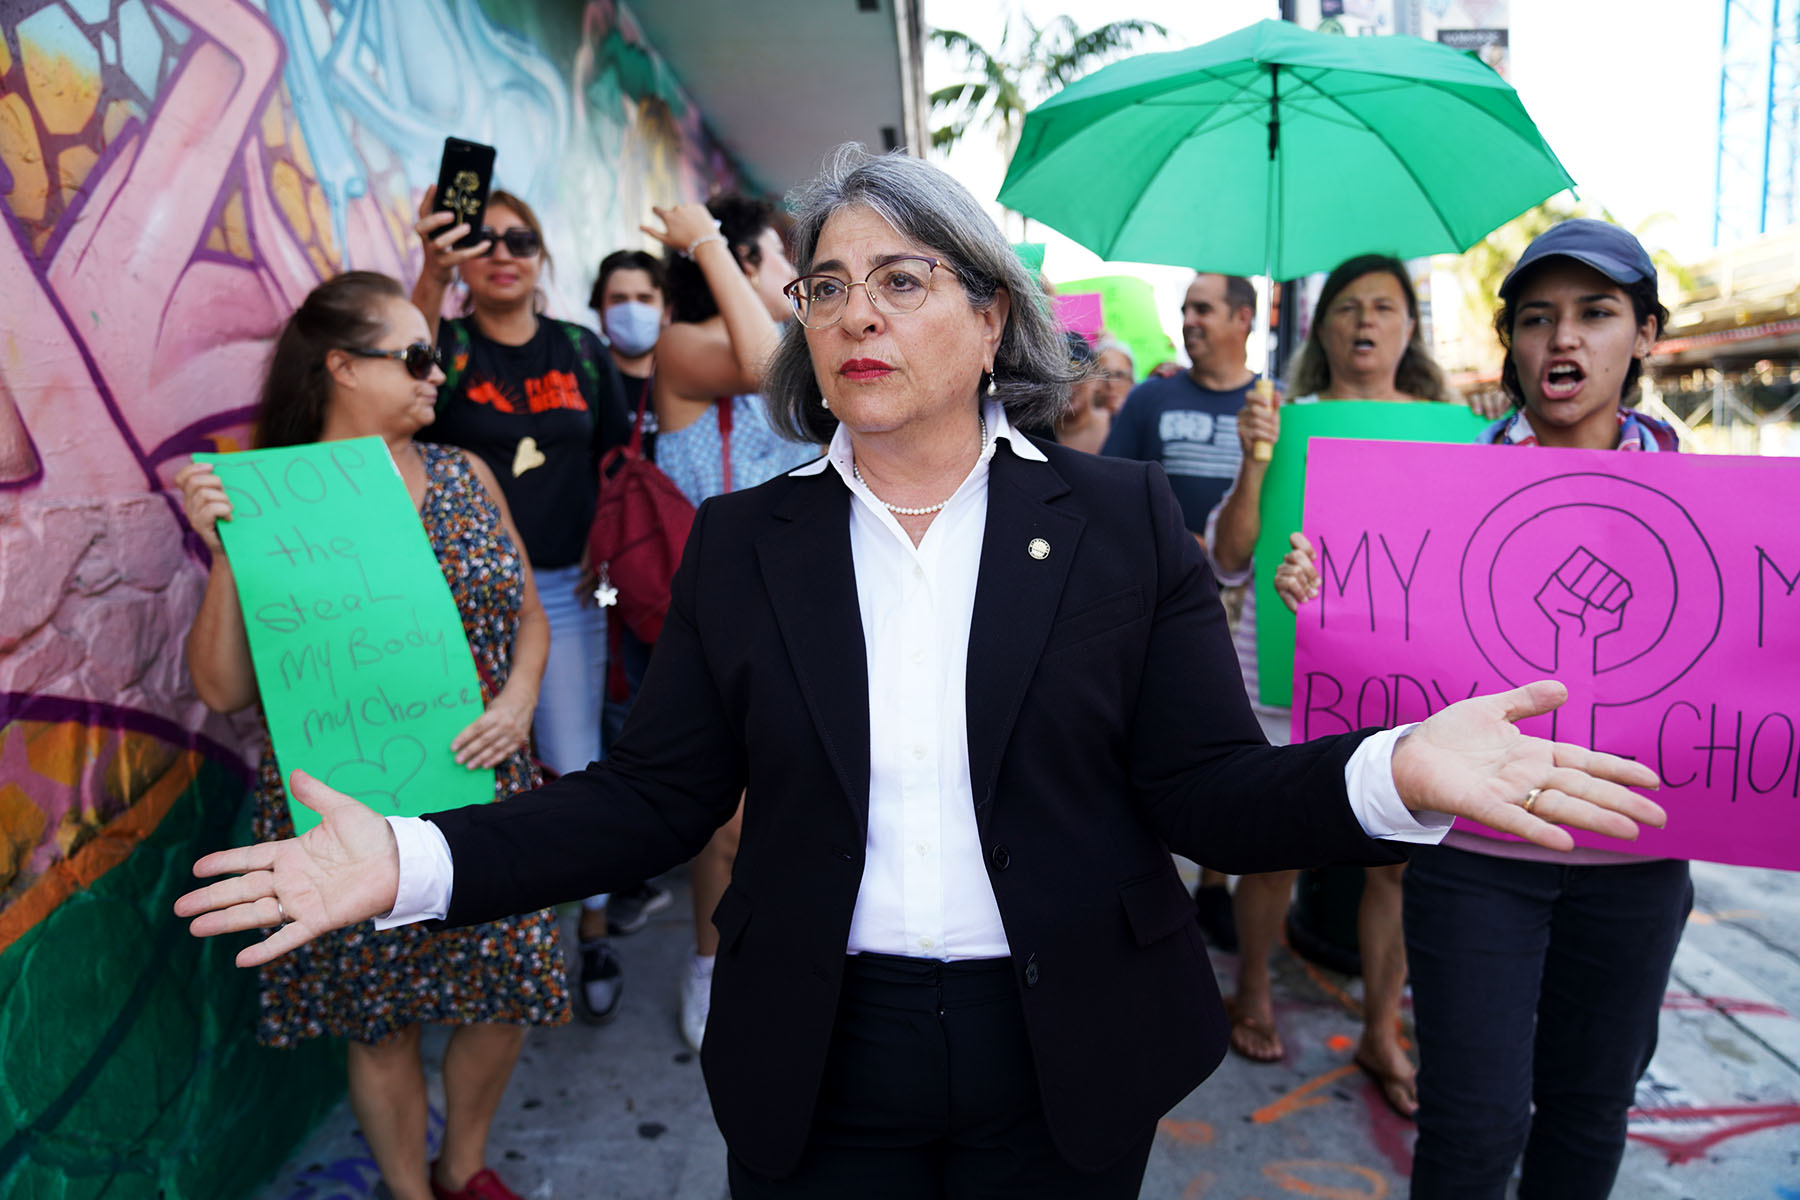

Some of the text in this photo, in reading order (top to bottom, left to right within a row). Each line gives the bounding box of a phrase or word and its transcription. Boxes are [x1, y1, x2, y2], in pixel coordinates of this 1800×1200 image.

[212, 445, 366, 518] STOP
[266, 525, 357, 567] the
[1319, 529, 1431, 642] MY
[350, 608, 450, 676] Body
